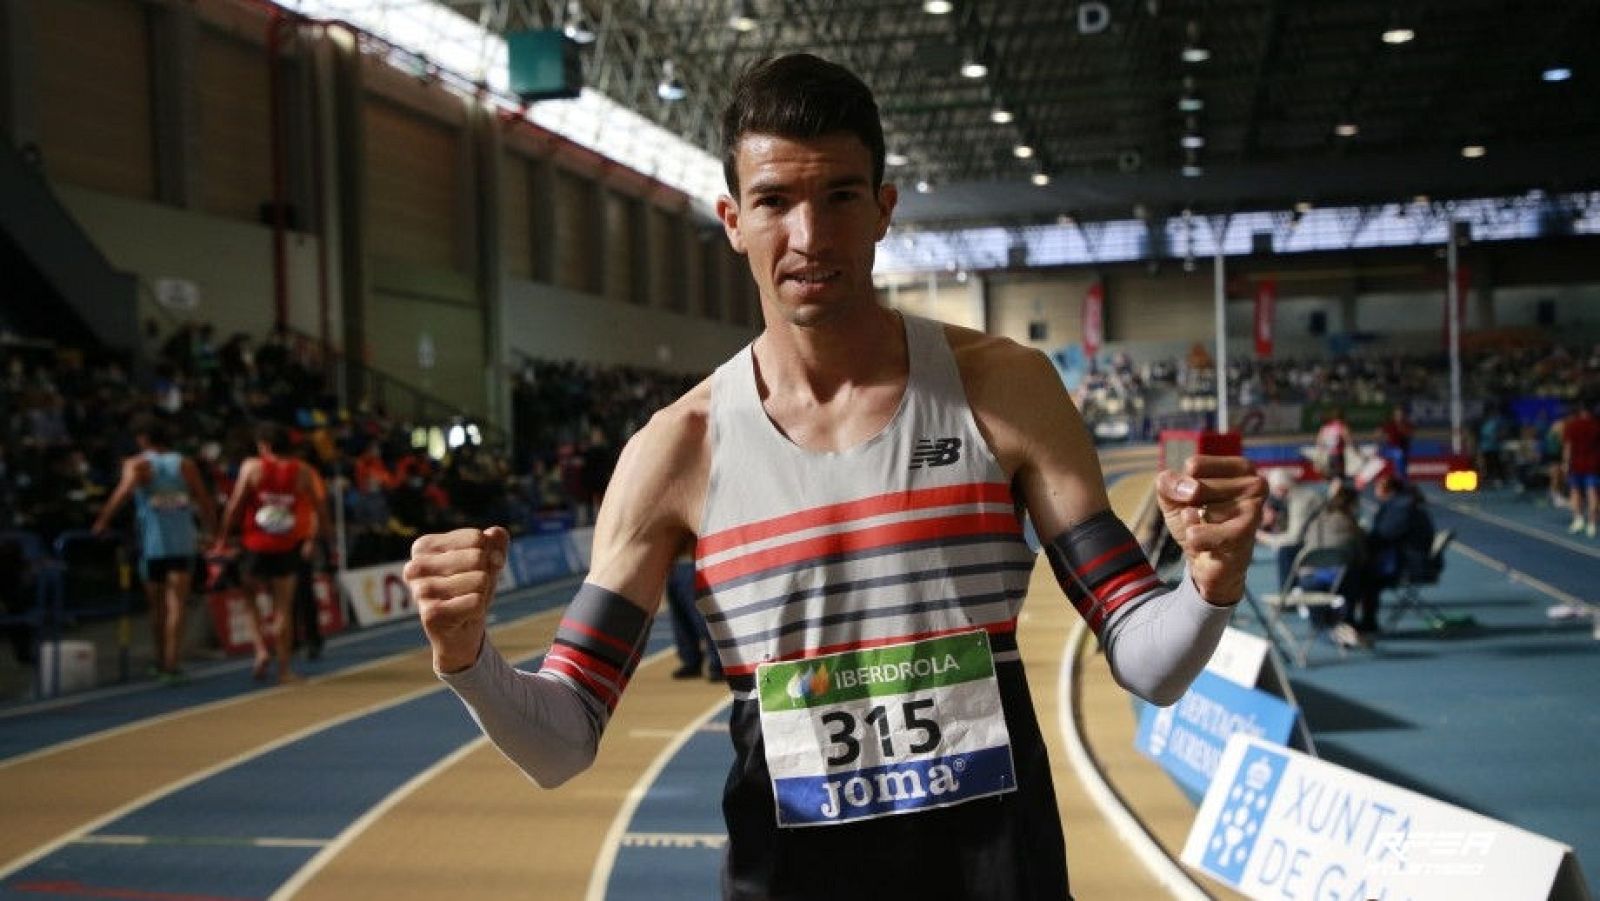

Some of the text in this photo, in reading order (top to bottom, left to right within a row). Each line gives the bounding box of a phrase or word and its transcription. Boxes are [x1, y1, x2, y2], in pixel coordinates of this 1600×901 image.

[1077, 2, 1110, 34] D
[836, 654, 960, 688] IBERDROLA
[821, 698, 942, 766] 315
[1283, 774, 1412, 867] XUNTA
[1258, 835, 1310, 898] DE
